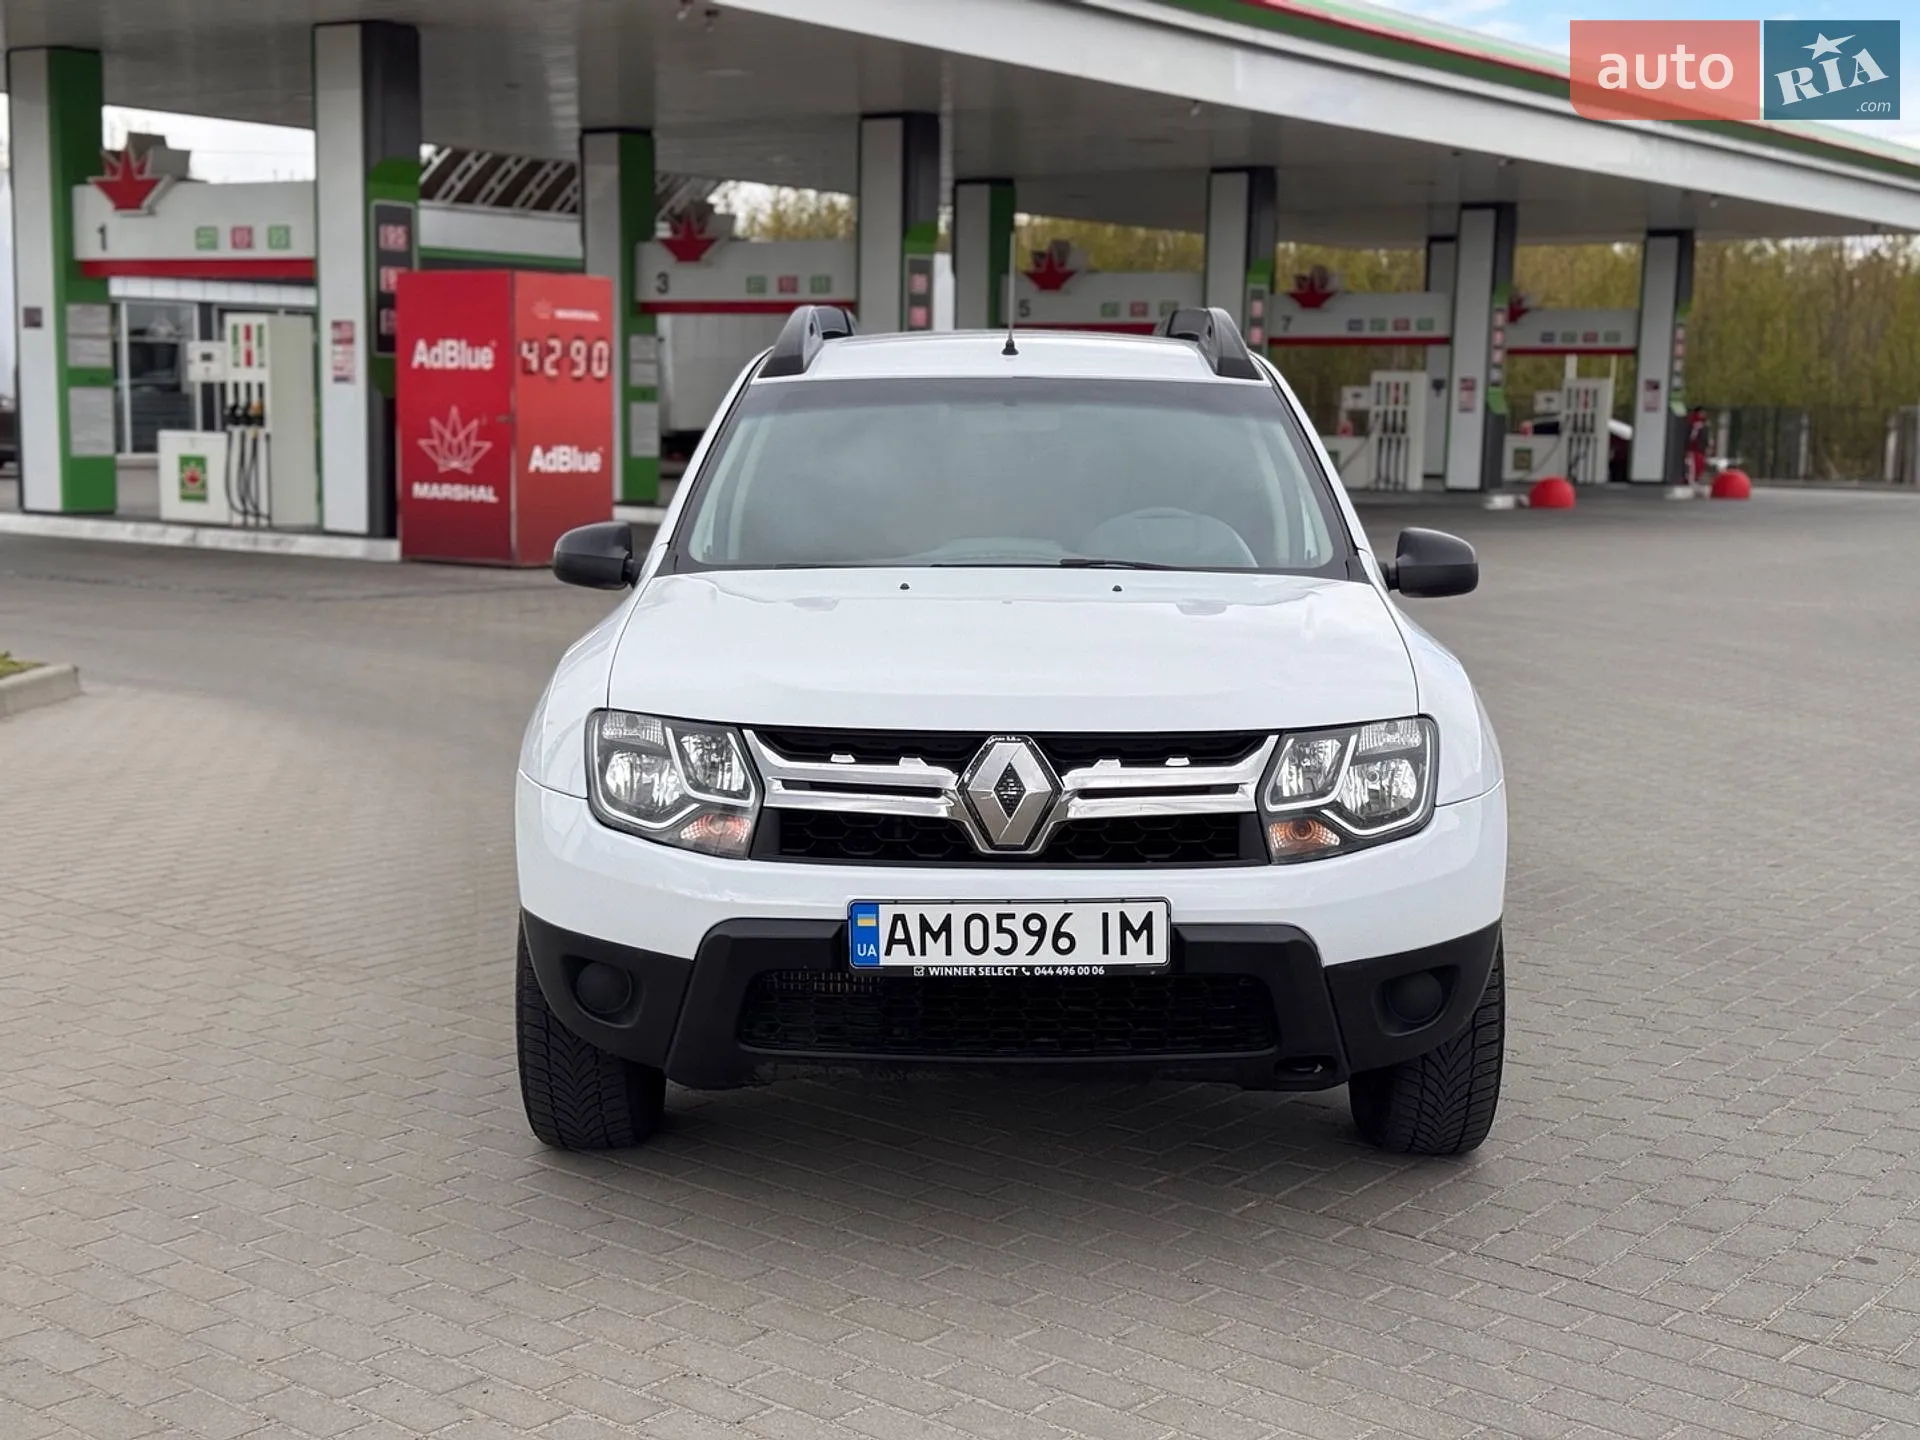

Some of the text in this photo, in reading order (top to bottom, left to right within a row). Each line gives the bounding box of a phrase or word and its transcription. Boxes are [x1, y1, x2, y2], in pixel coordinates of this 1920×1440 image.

[97, 224, 107, 251] 1
[656, 272, 670, 294] 3
[1018, 299, 1031, 318] 5
[412, 482, 499, 503] MARSHAL
[857, 943, 877, 957] UA
[928, 966, 1105, 976] WINNER SELECT 044 496 00 06
